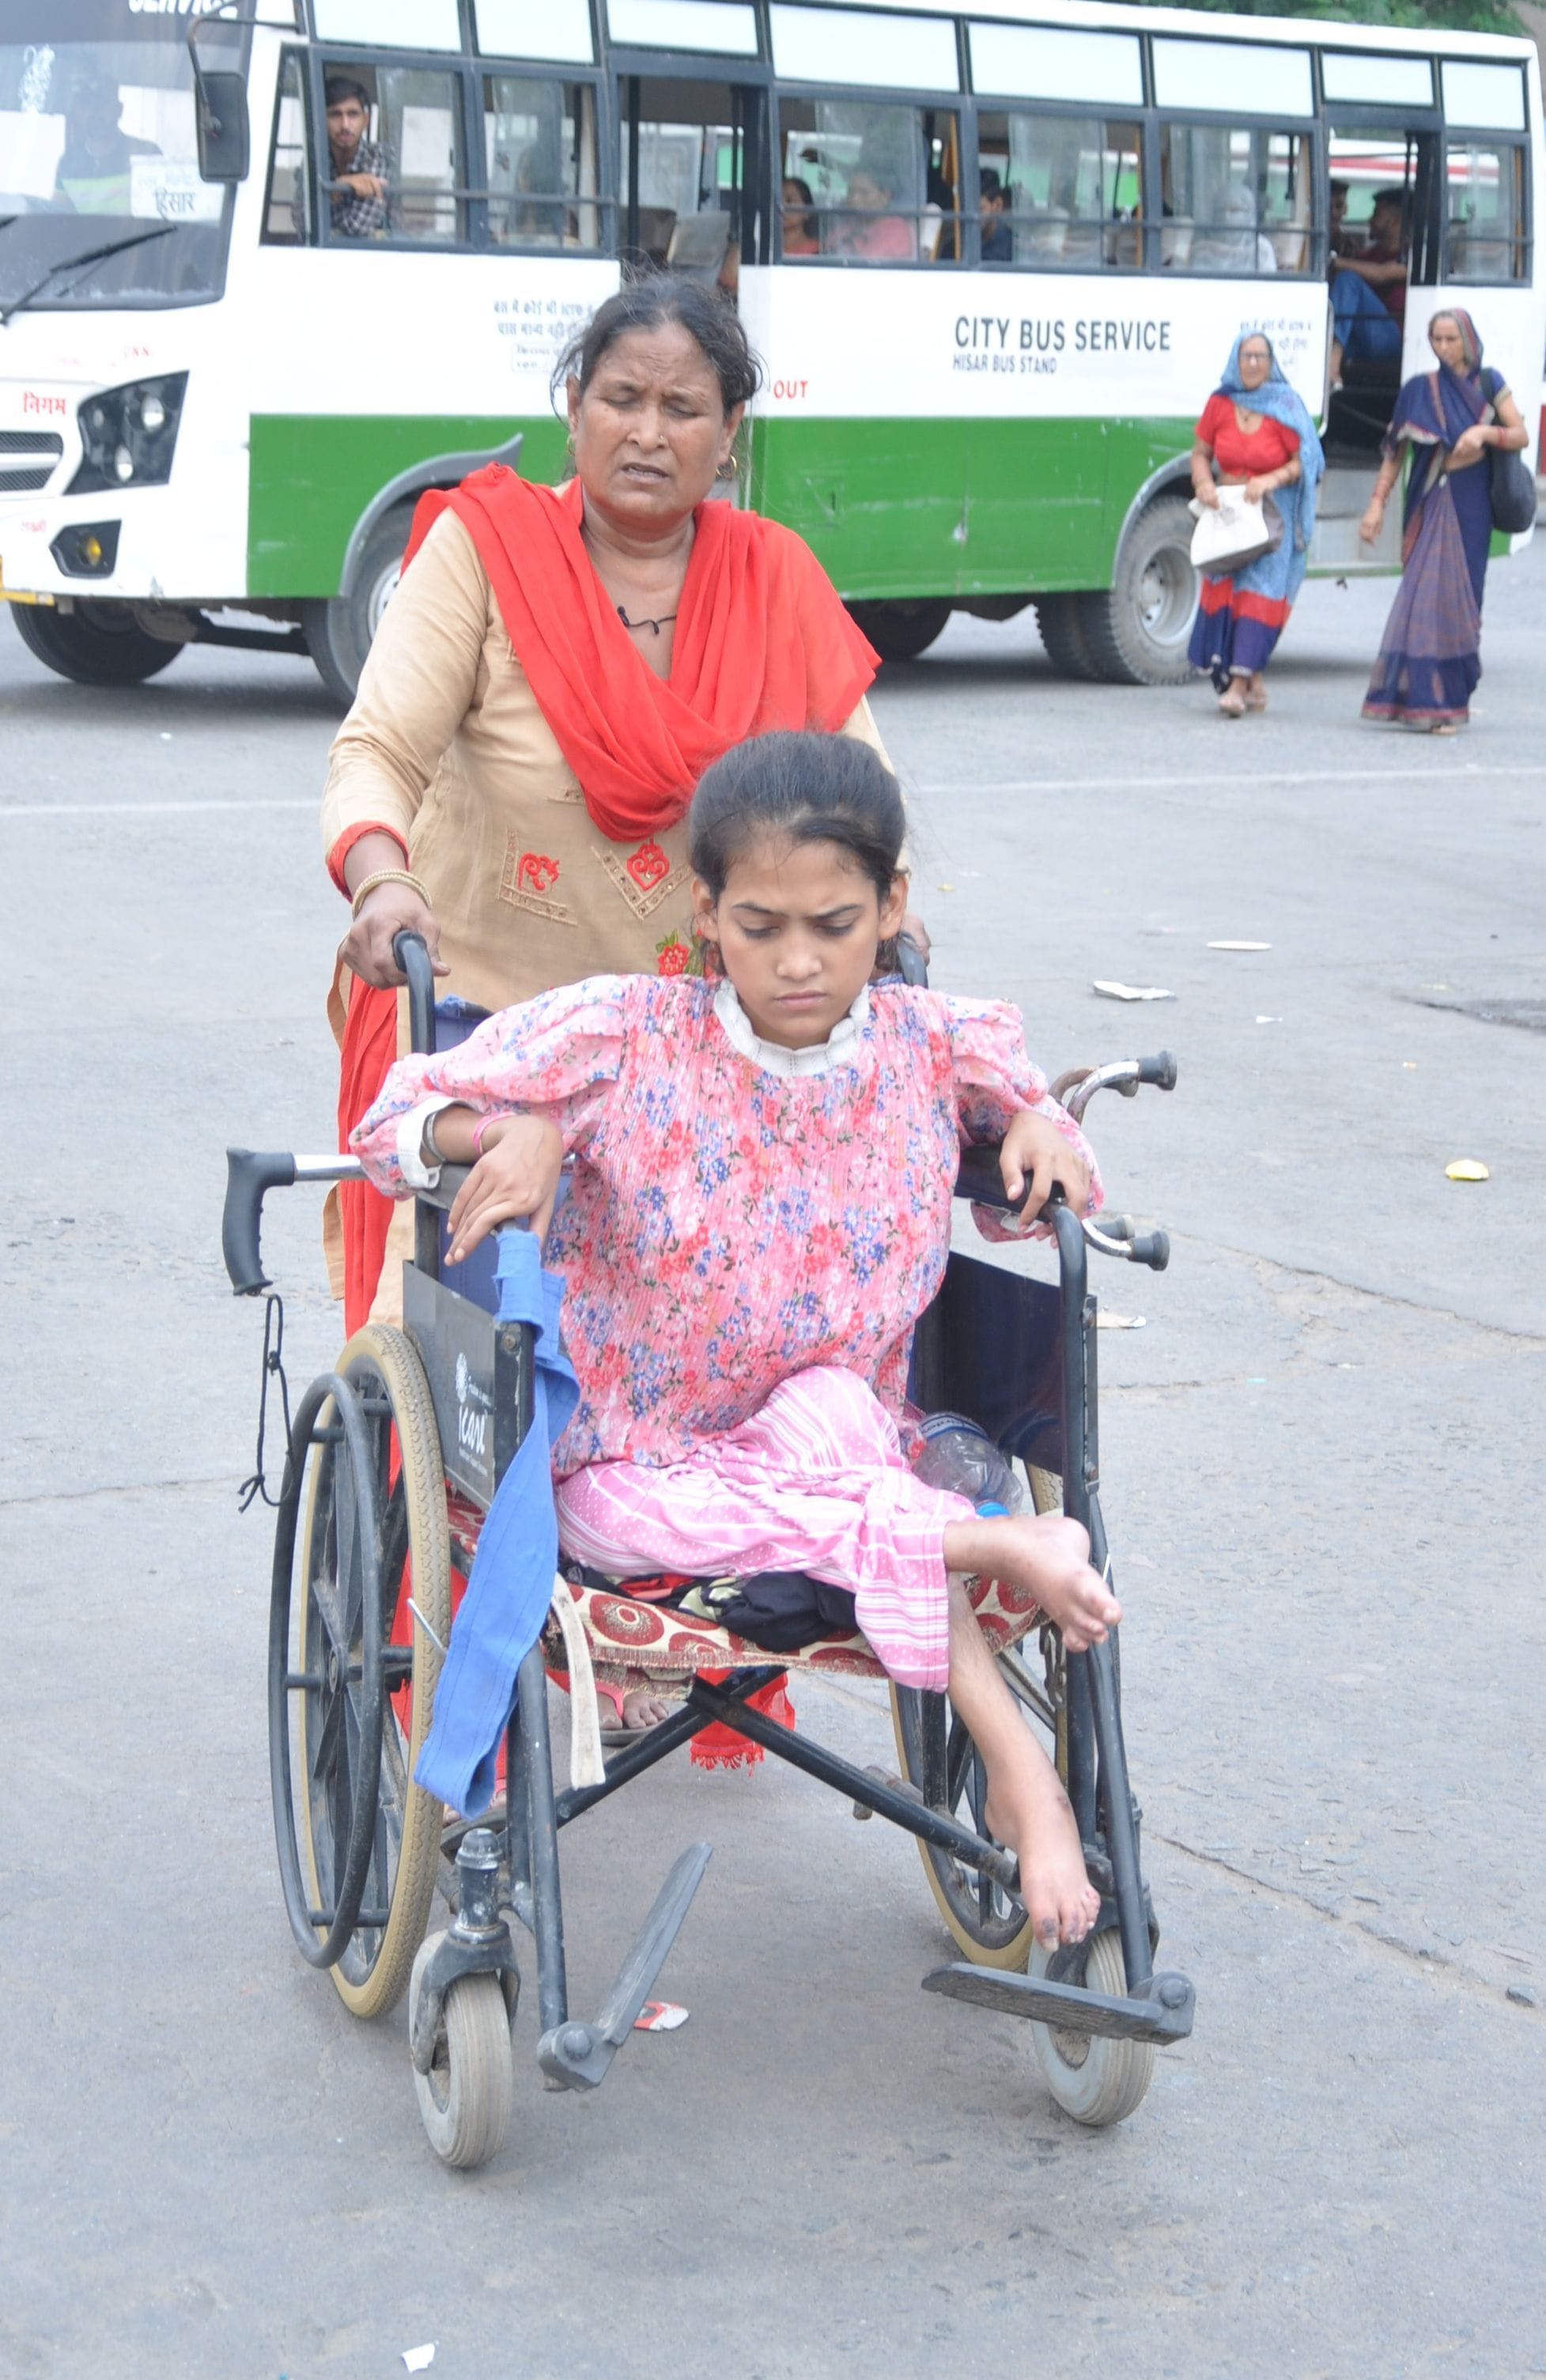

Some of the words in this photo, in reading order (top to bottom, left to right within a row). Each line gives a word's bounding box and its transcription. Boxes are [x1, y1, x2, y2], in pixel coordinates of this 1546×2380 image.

[955, 315, 1010, 348] CITY
[1020, 319, 1065, 350] BUS
[1075, 320, 1170, 350] SERVICE
[953, 353, 988, 372] HISAR
[992, 355, 1015, 373] BUS
[1020, 357, 1057, 374] STAND
[773, 380, 808, 399] OUT
[23, 391, 66, 415] निगम
